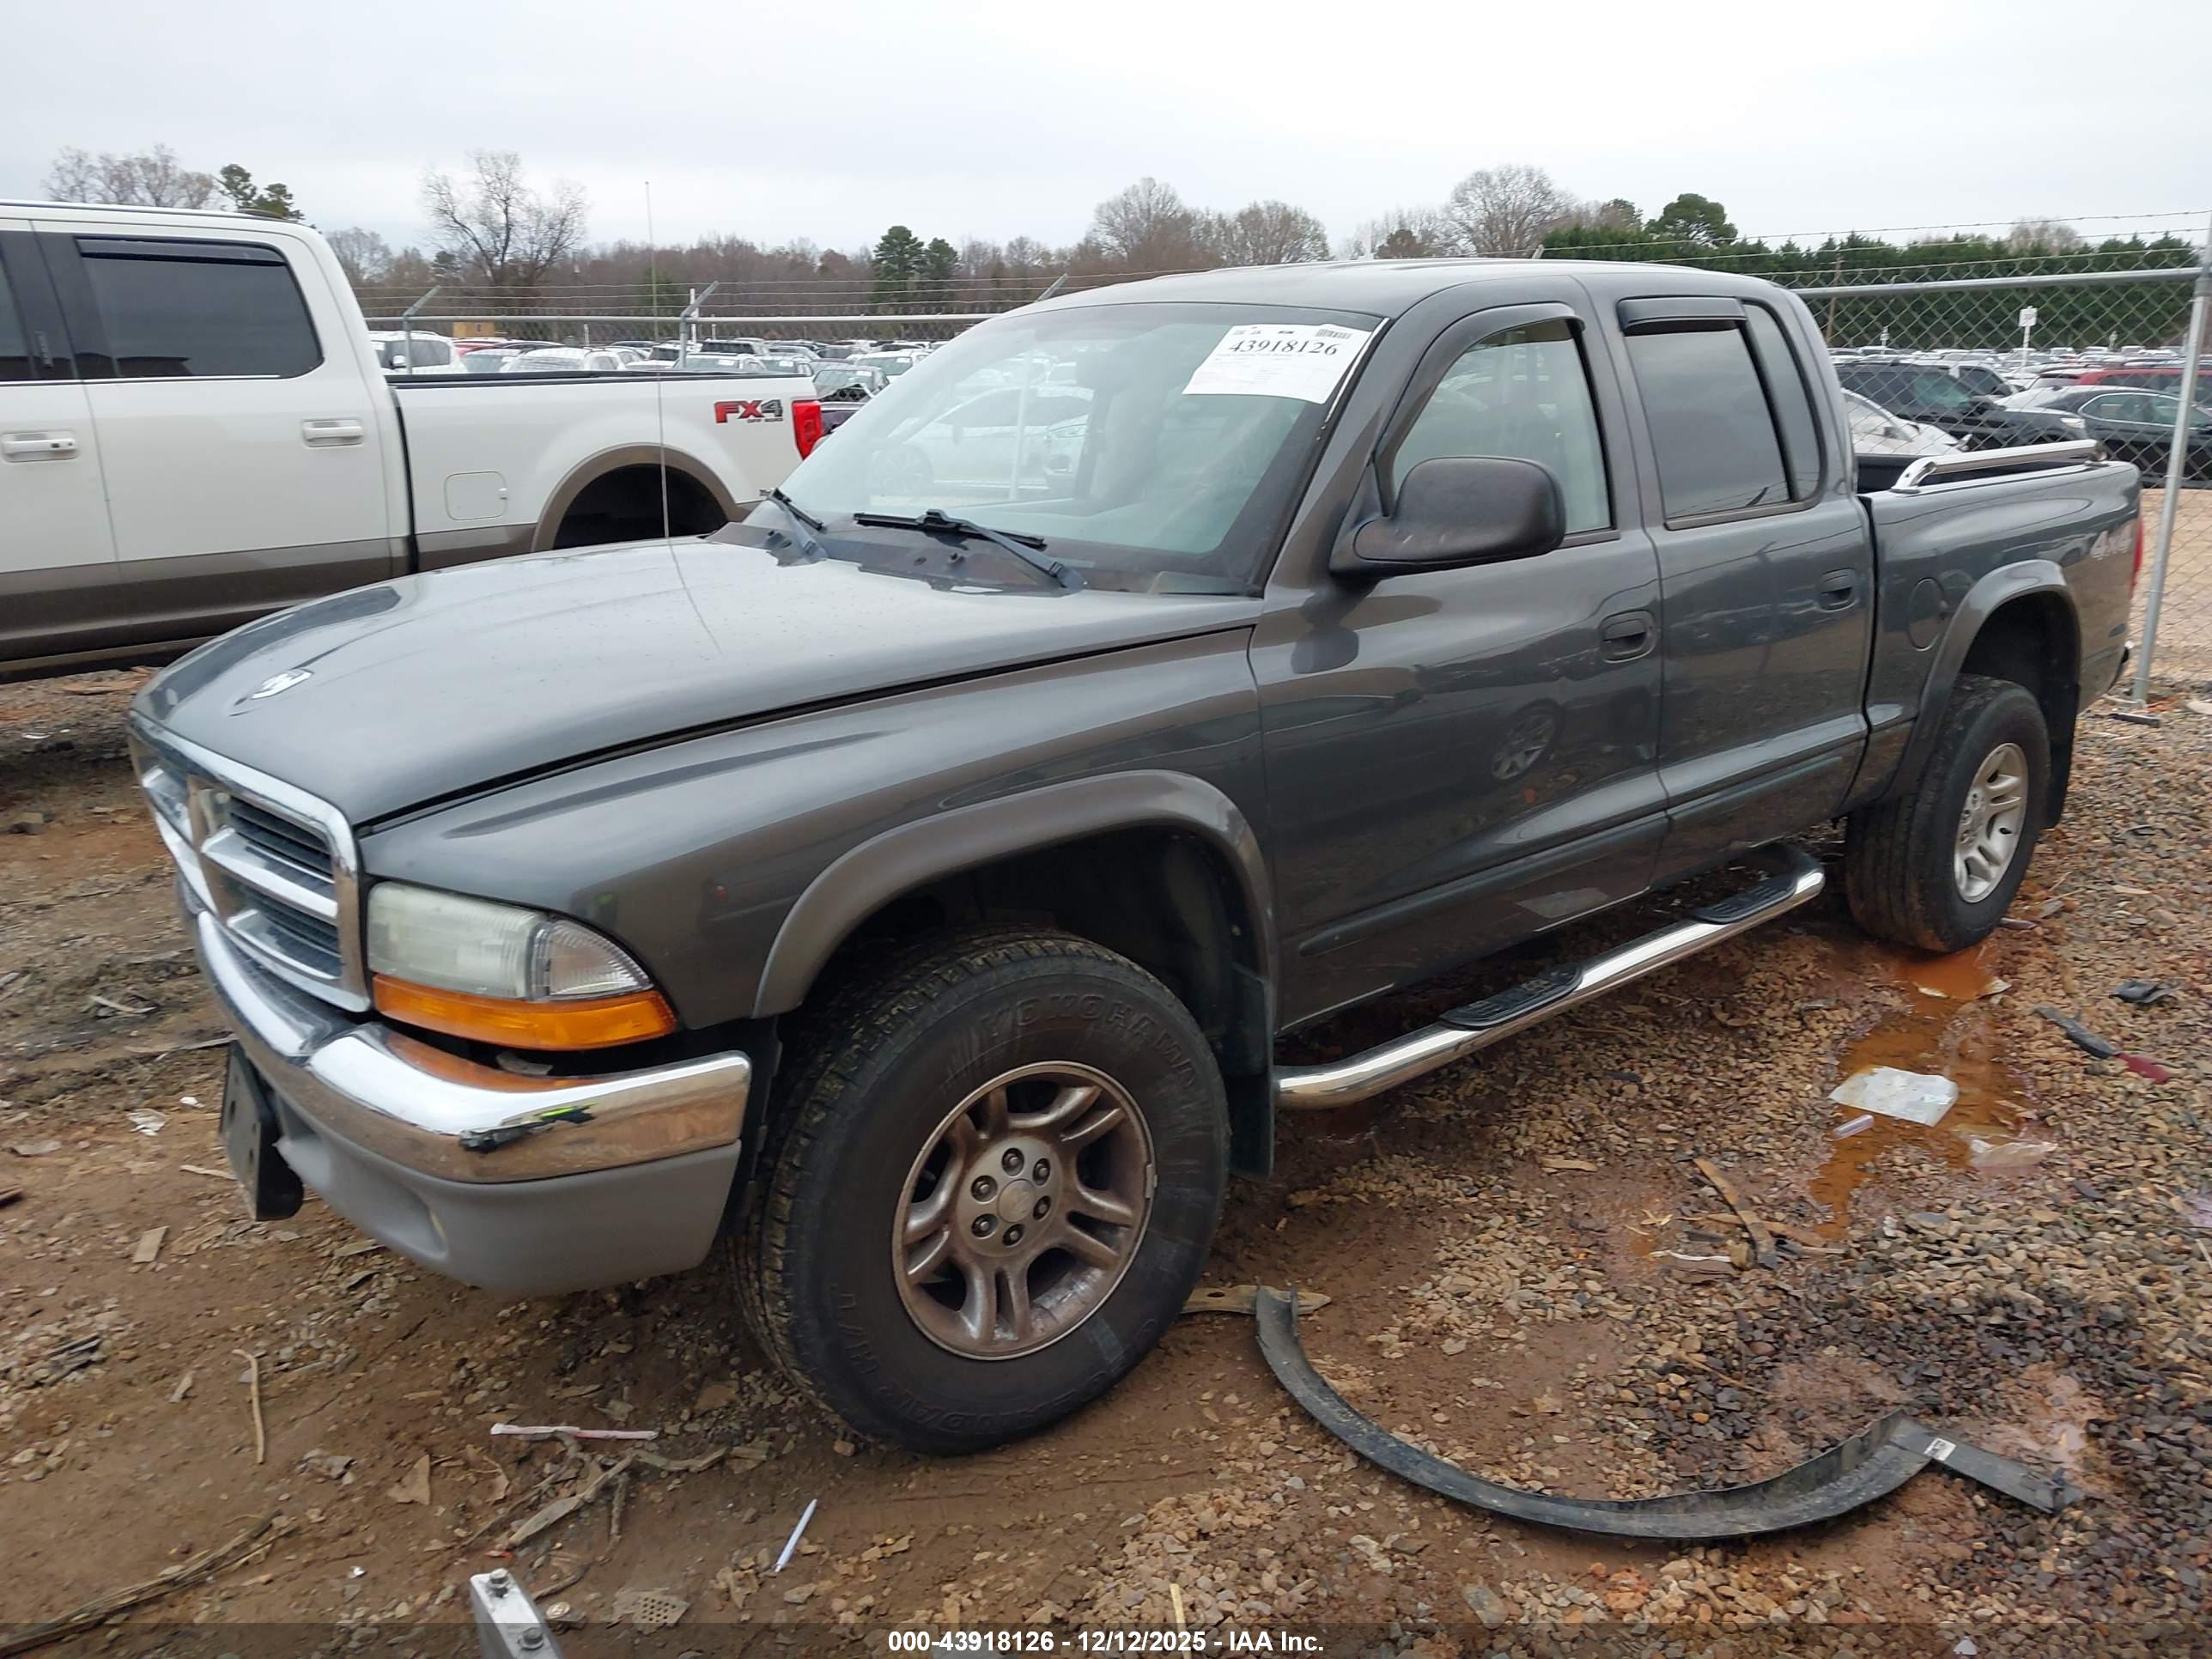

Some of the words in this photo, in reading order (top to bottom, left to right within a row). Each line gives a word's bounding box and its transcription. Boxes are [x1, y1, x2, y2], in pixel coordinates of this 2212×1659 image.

[1229, 339, 1341, 356] 43918126
[714, 399, 783, 423] FX4
[978, 993, 1197, 1091] YOKOHAMA
